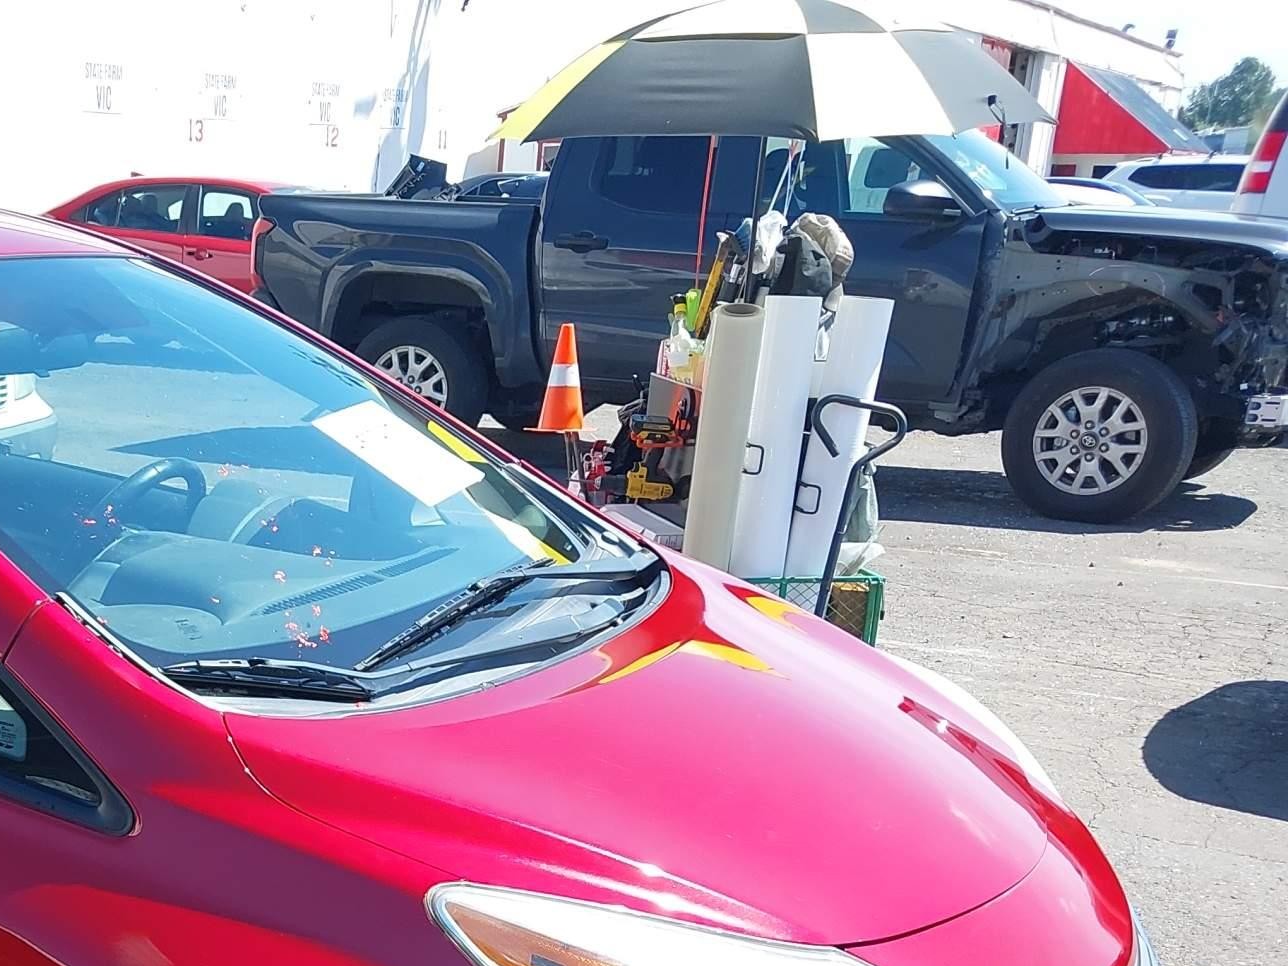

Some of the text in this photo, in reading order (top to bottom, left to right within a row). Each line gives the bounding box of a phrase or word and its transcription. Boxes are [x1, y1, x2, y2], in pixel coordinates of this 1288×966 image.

[85, 62, 123, 81] STATE FARM
[96, 85, 112, 110] VIC
[214, 95, 227, 117] VIC
[188, 118, 204, 142] 13
[325, 125, 339, 148] 12
